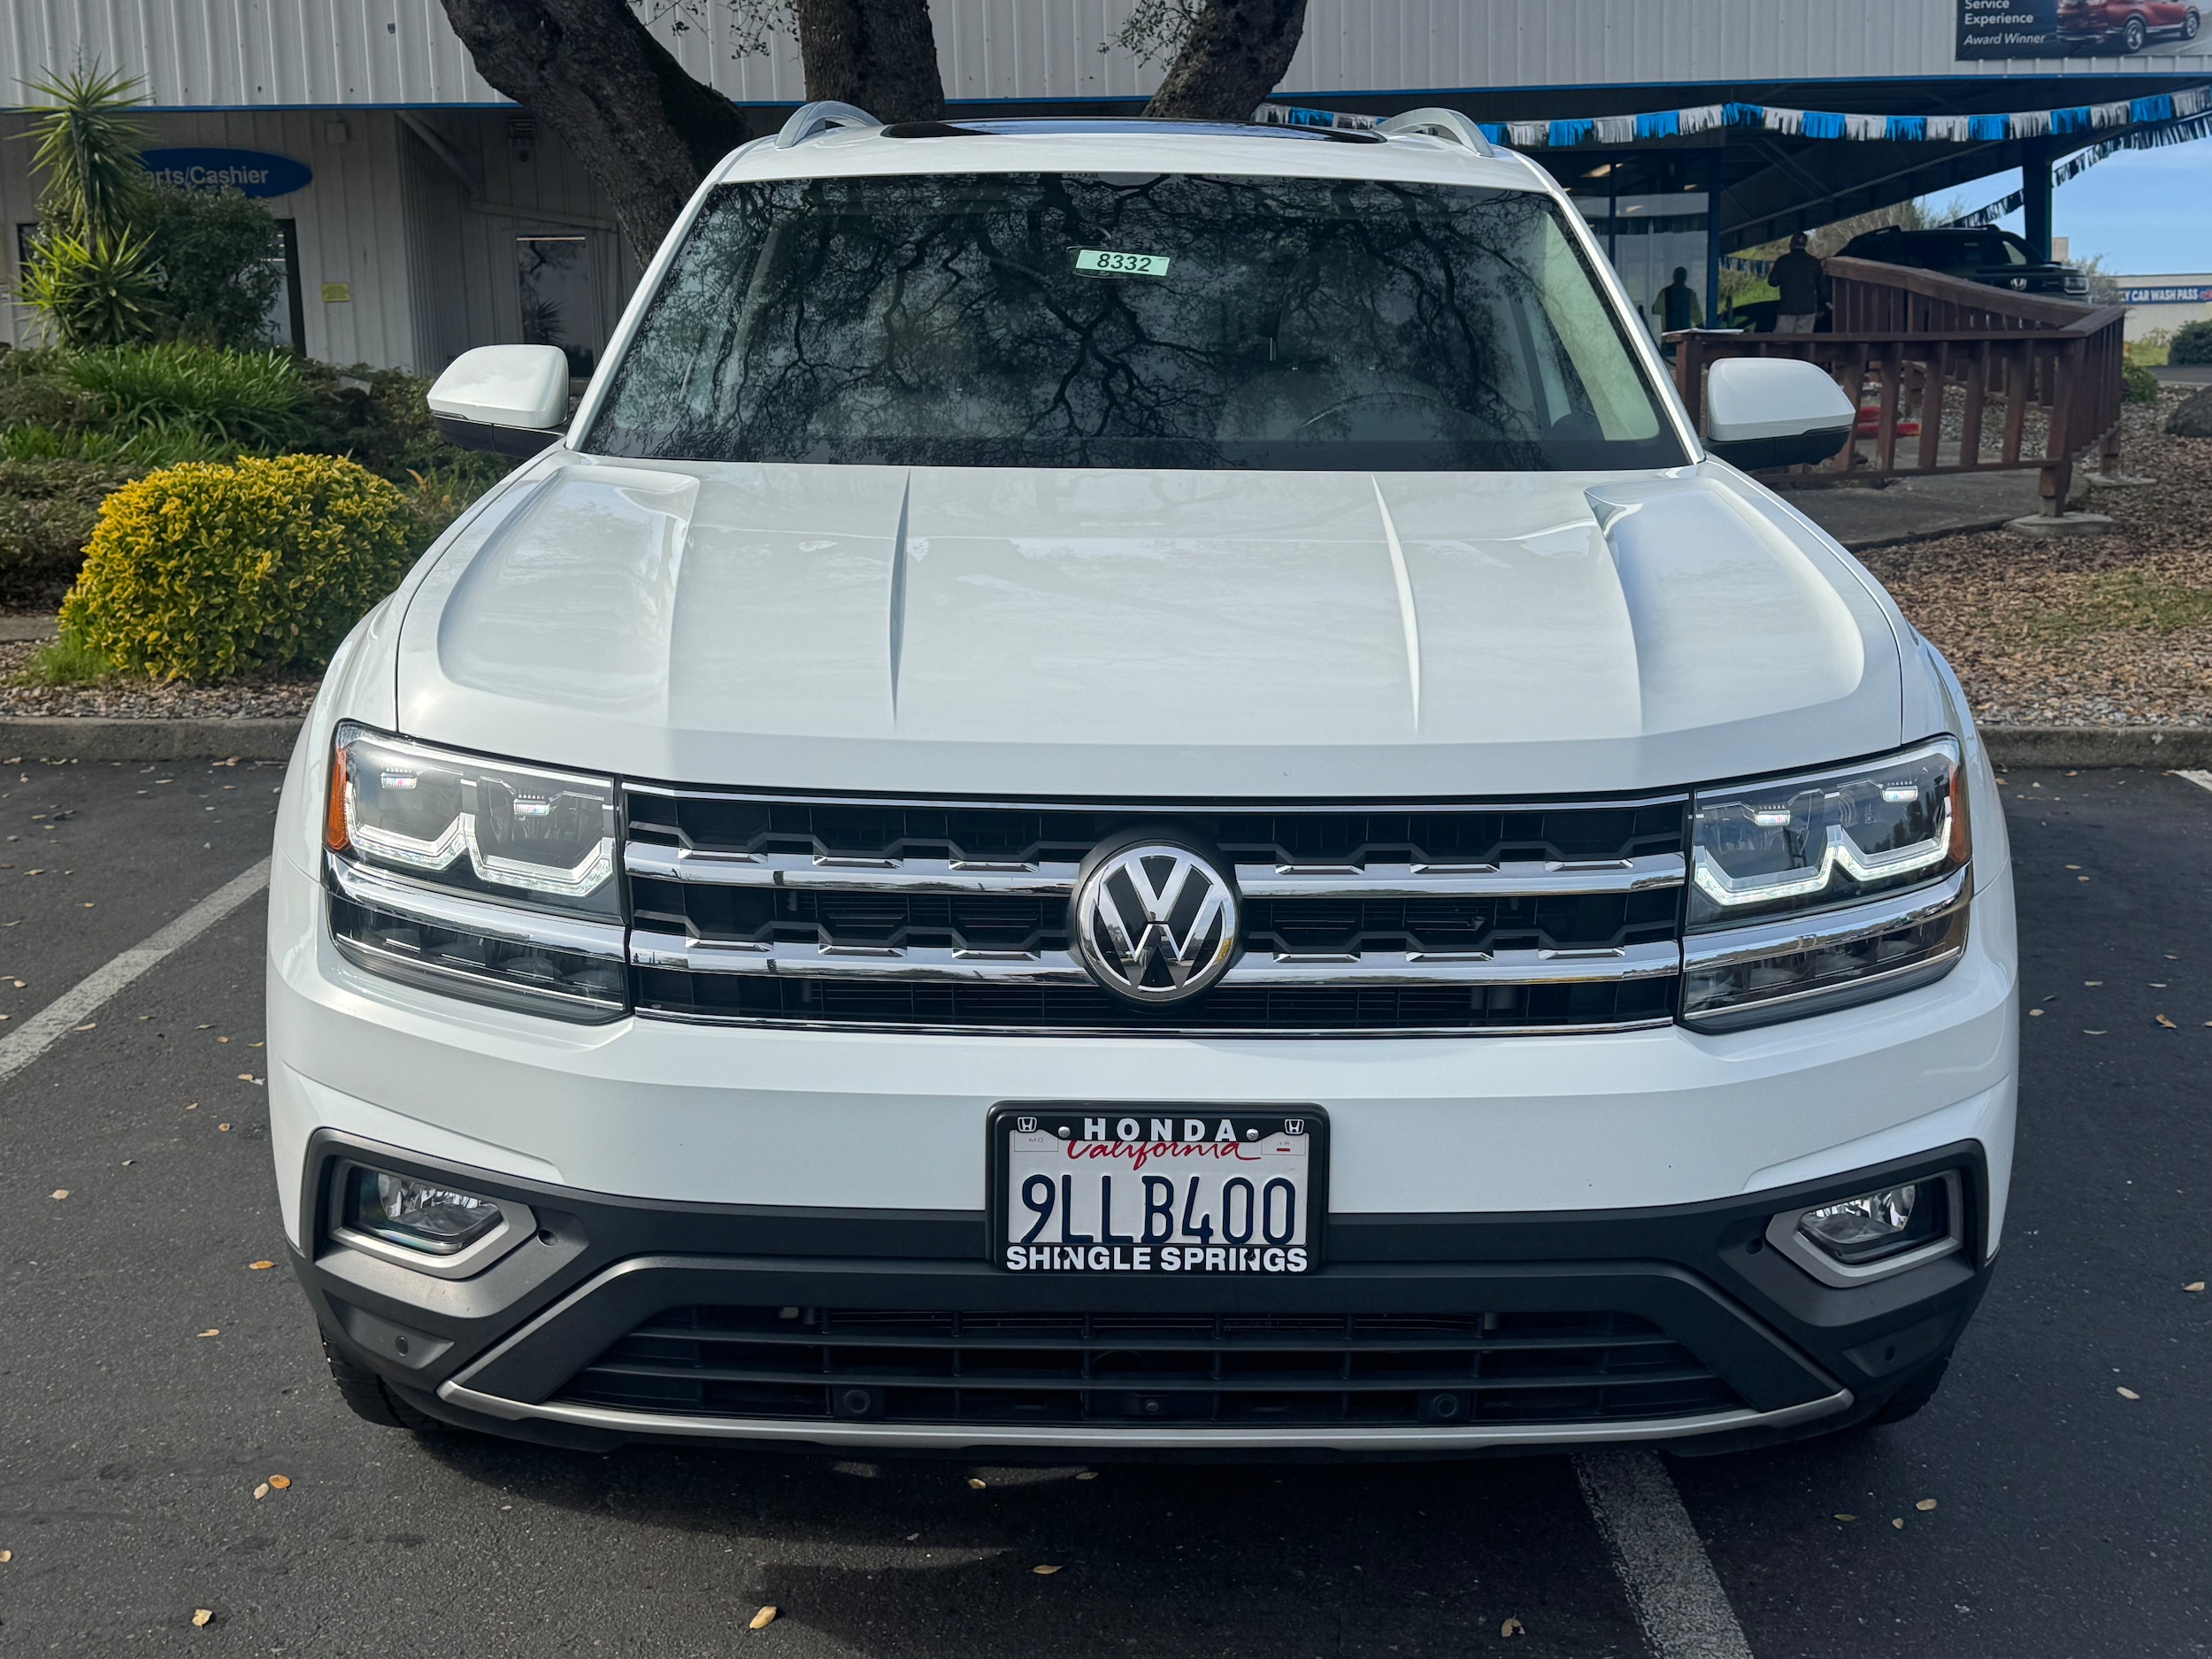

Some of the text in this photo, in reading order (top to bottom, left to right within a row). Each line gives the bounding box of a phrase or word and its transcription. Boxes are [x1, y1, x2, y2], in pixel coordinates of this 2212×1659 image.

[1964, 0, 2010, 10] Service
[1964, 12, 2034, 27] Experience
[1963, 33, 2046, 45] Award Winner
[143, 165, 269, 185] arts/Cashier
[1097, 253, 1152, 272] 8332
[2131, 289, 2150, 301] CAR
[2151, 288, 2177, 300] WASH
[2177, 288, 2199, 300] PASS
[1079, 846, 1236, 1001] VW
[1084, 1118, 1237, 1141] HONDA
[1067, 1139, 1262, 1171] California
[1022, 1174, 1296, 1244] 9LLB400
[1006, 1246, 1308, 1272] SHINGLE SPRINGS
